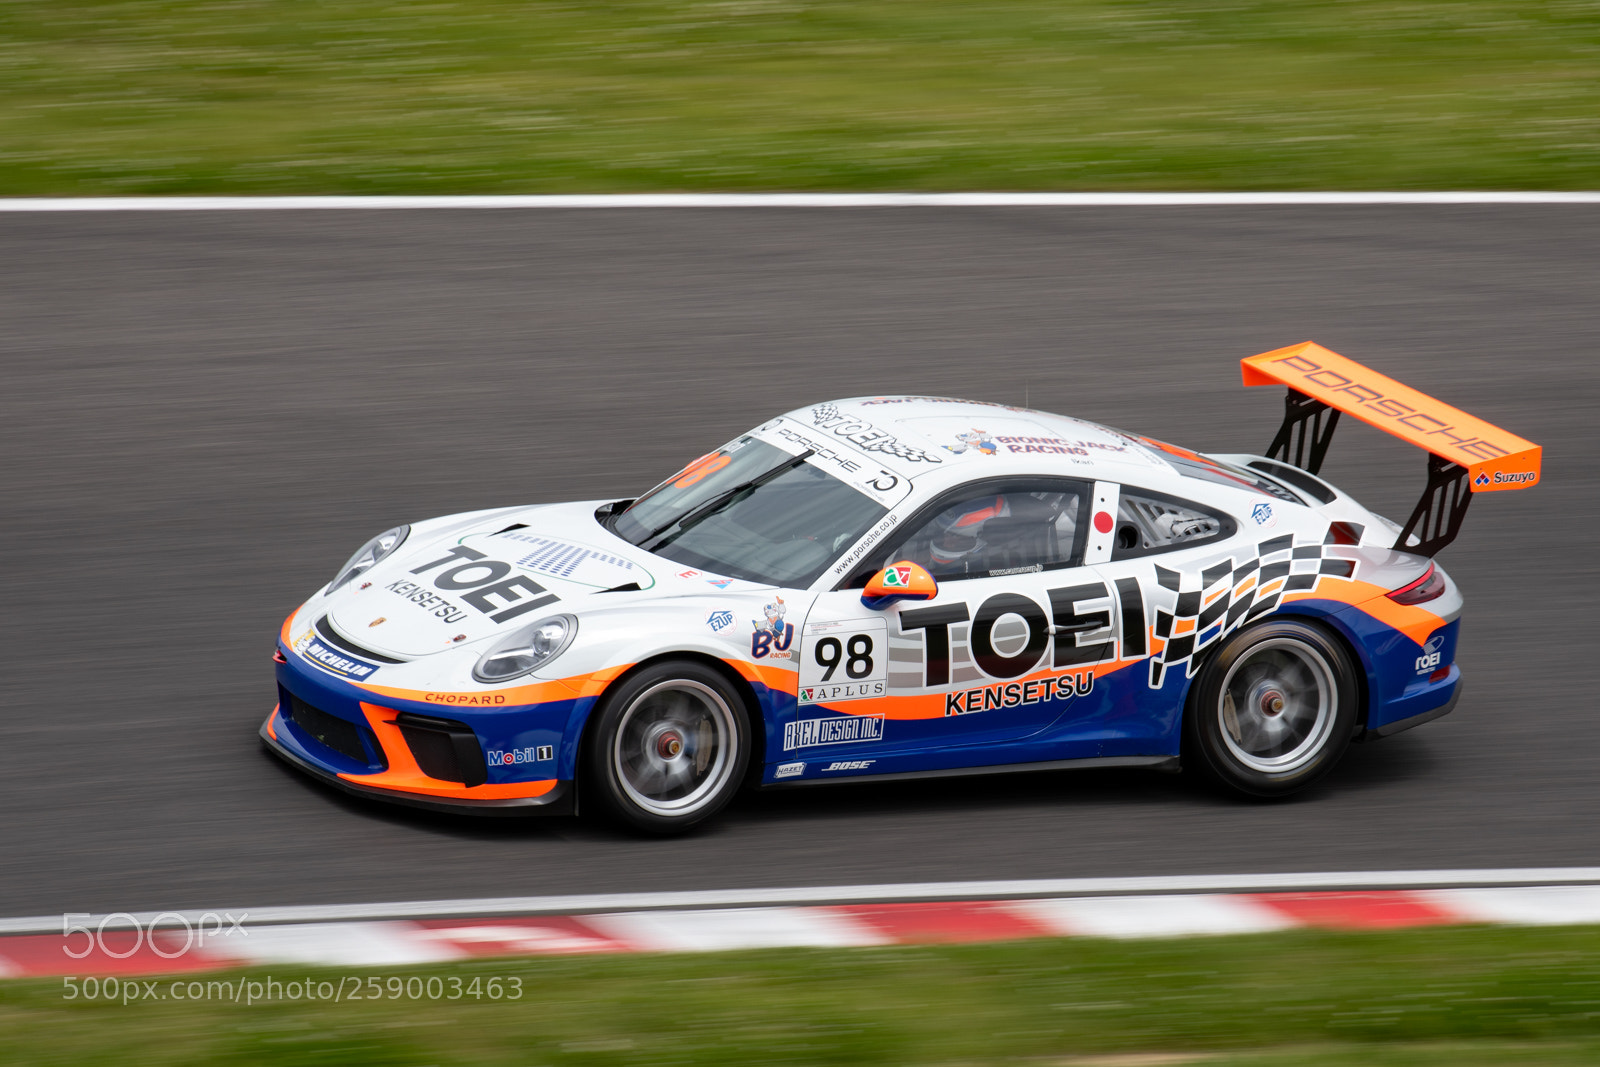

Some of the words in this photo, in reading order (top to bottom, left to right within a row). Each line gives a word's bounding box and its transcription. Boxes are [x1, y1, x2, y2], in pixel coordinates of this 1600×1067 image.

[1271, 355, 1511, 461] PORSCHE
[821, 414, 898, 451] TOEI
[995, 436, 1069, 447] BIONIC
[1073, 440, 1127, 453] JACK
[778, 428, 862, 473] PORSCHE
[1007, 444, 1089, 457] RACING
[1493, 470, 1536, 484] Suzuyo
[834, 514, 898, 575] www.porsche.co.jp
[385, 579, 468, 624] KENSETSU
[409, 545, 562, 624] TOEI
[897, 576, 1150, 688] TOEI
[307, 643, 373, 677] MICHELIN
[815, 633, 874, 683] 98
[425, 692, 506, 706] CHOPARD
[816, 682, 883, 700] APLUS
[945, 671, 1094, 716] KENSETSU
[785, 720, 820, 749] AXEL
[820, 718, 860, 742] DESIGN
[860, 717, 881, 739] INC.
[488, 748, 535, 767] Mobil
[537, 745, 554, 762] 1
[821, 760, 876, 772] BOSE
